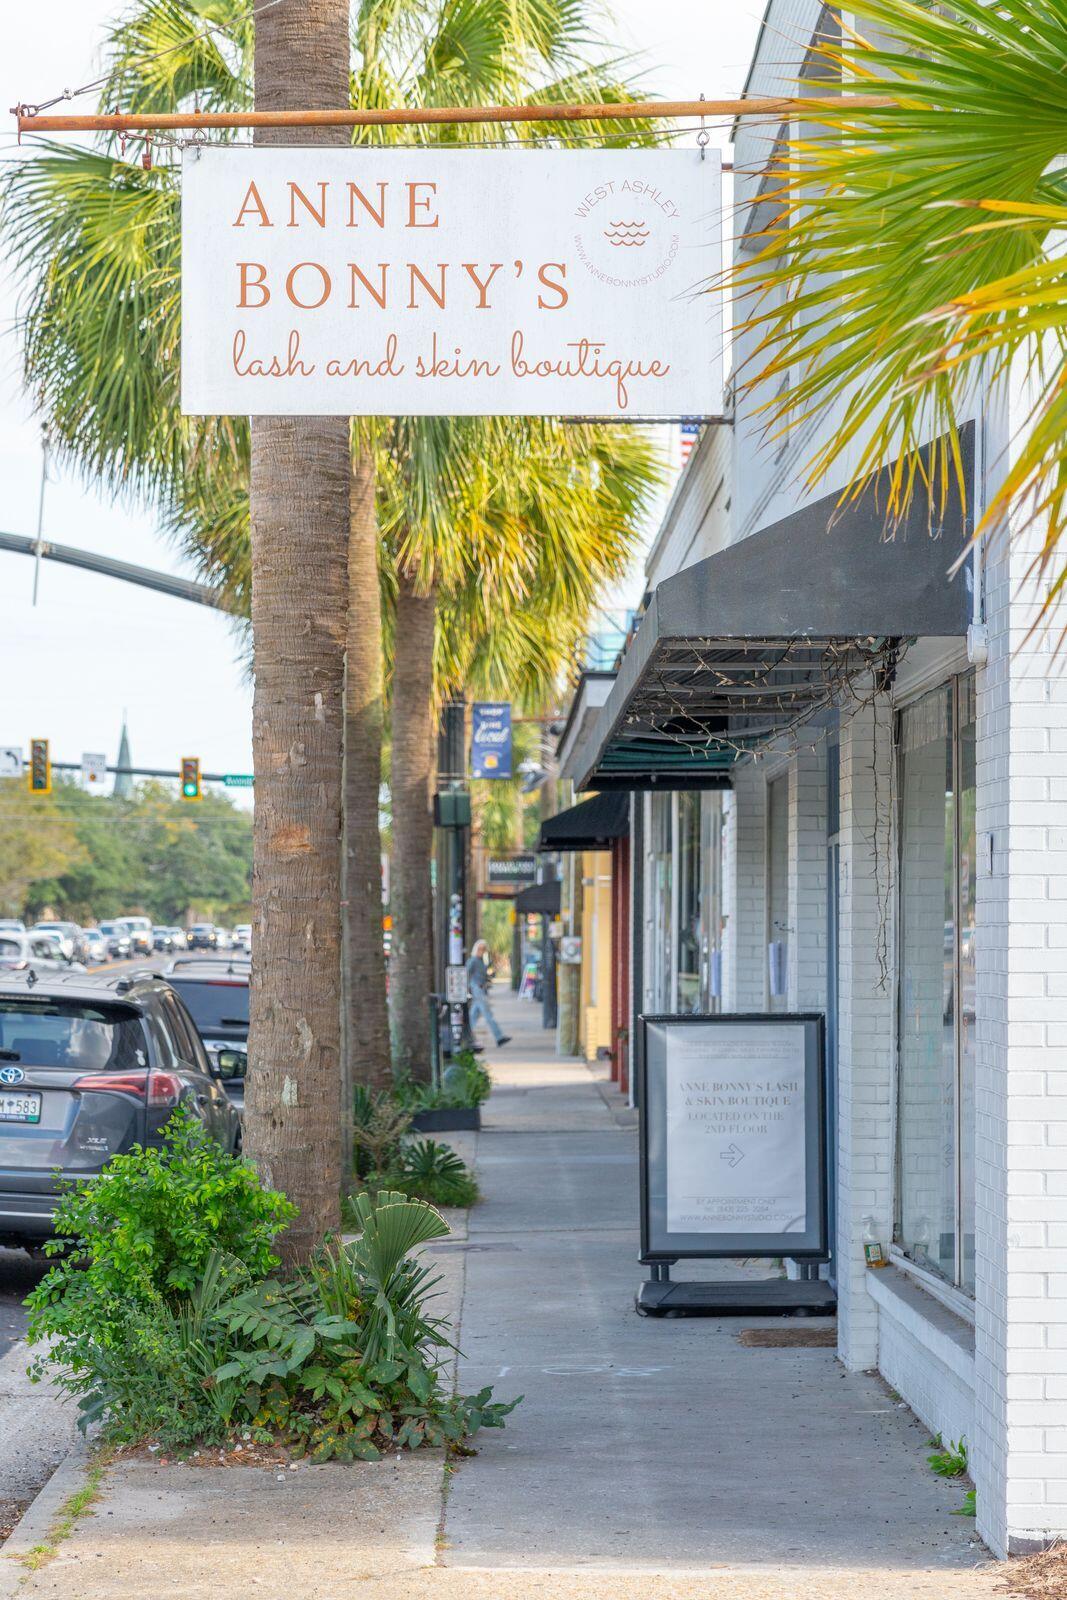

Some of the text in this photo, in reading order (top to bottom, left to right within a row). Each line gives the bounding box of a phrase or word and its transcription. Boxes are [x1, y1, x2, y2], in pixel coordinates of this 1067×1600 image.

[231, 180, 440, 228] ANNE
[574, 179, 681, 219] WEST ASHLEY
[574, 233, 680, 288] WWW.ANNEBONNYSTUDIO.COM
[236, 259, 569, 310] BONNY'S
[232, 330, 670, 409] lash and skin boutique
[679, 1082, 709, 1092] ANNE
[766, 1082, 799, 1092] LASH
[685, 1096, 792, 1107] & SKIN BOUTIQUE
[688, 1111, 785, 1121] LOCATED ON THE
[704, 1125, 768, 1134] 2ND FLOOR
